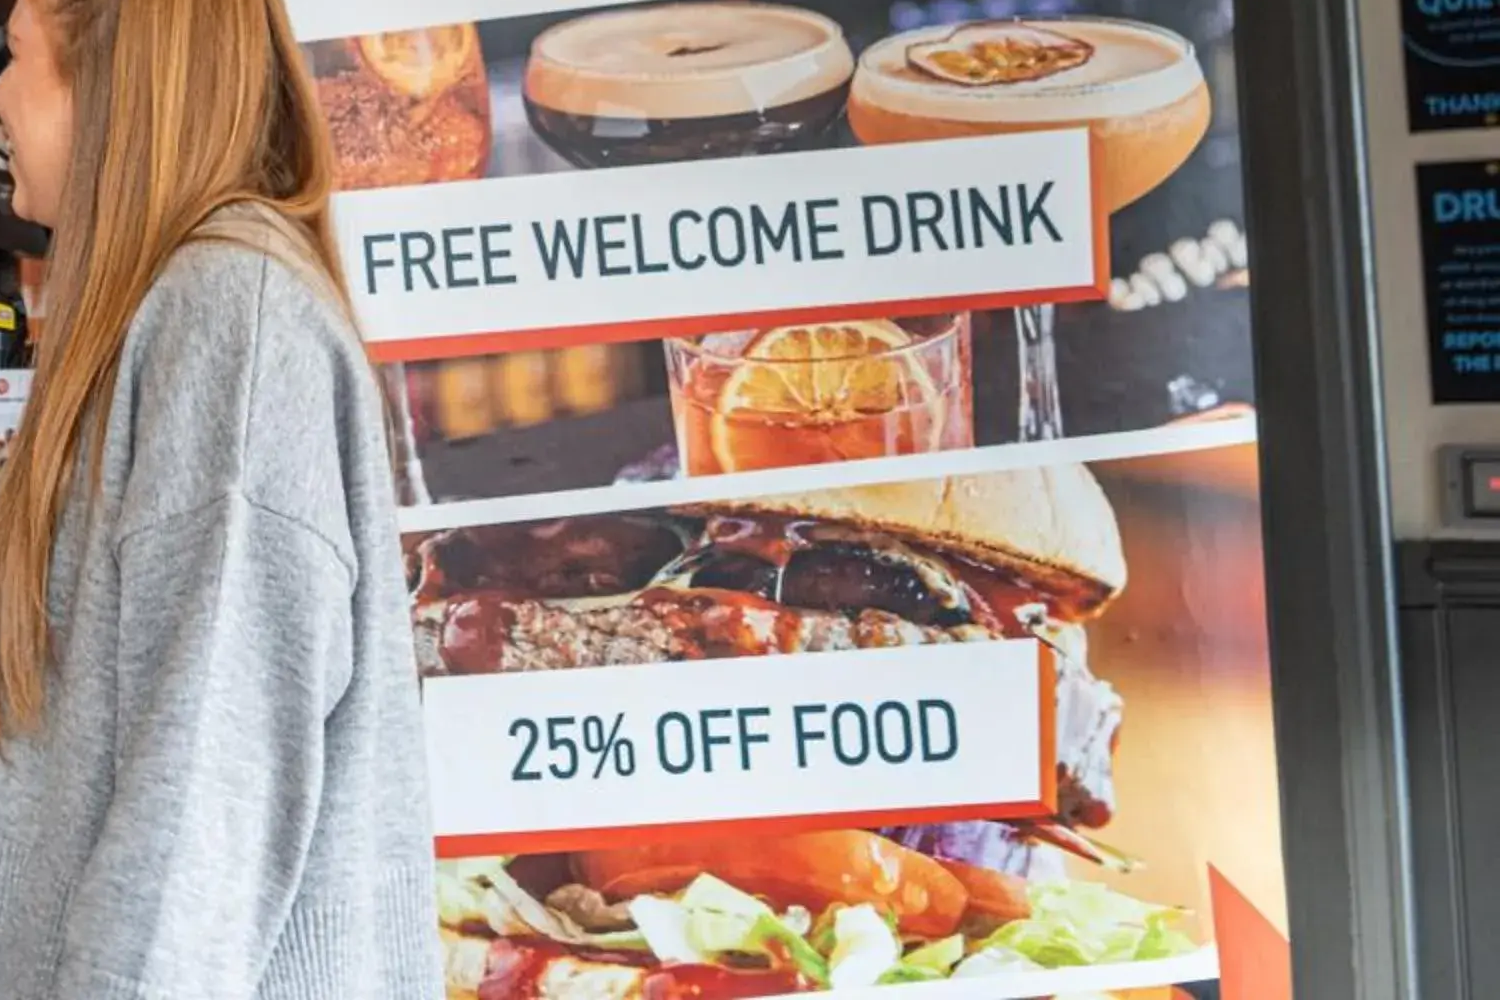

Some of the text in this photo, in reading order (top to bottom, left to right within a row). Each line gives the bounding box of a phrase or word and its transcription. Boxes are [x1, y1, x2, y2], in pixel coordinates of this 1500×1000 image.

[362, 180, 1065, 295] FREE WELCOME DRINK
[508, 698, 960, 782] 25% OFF FOOD
